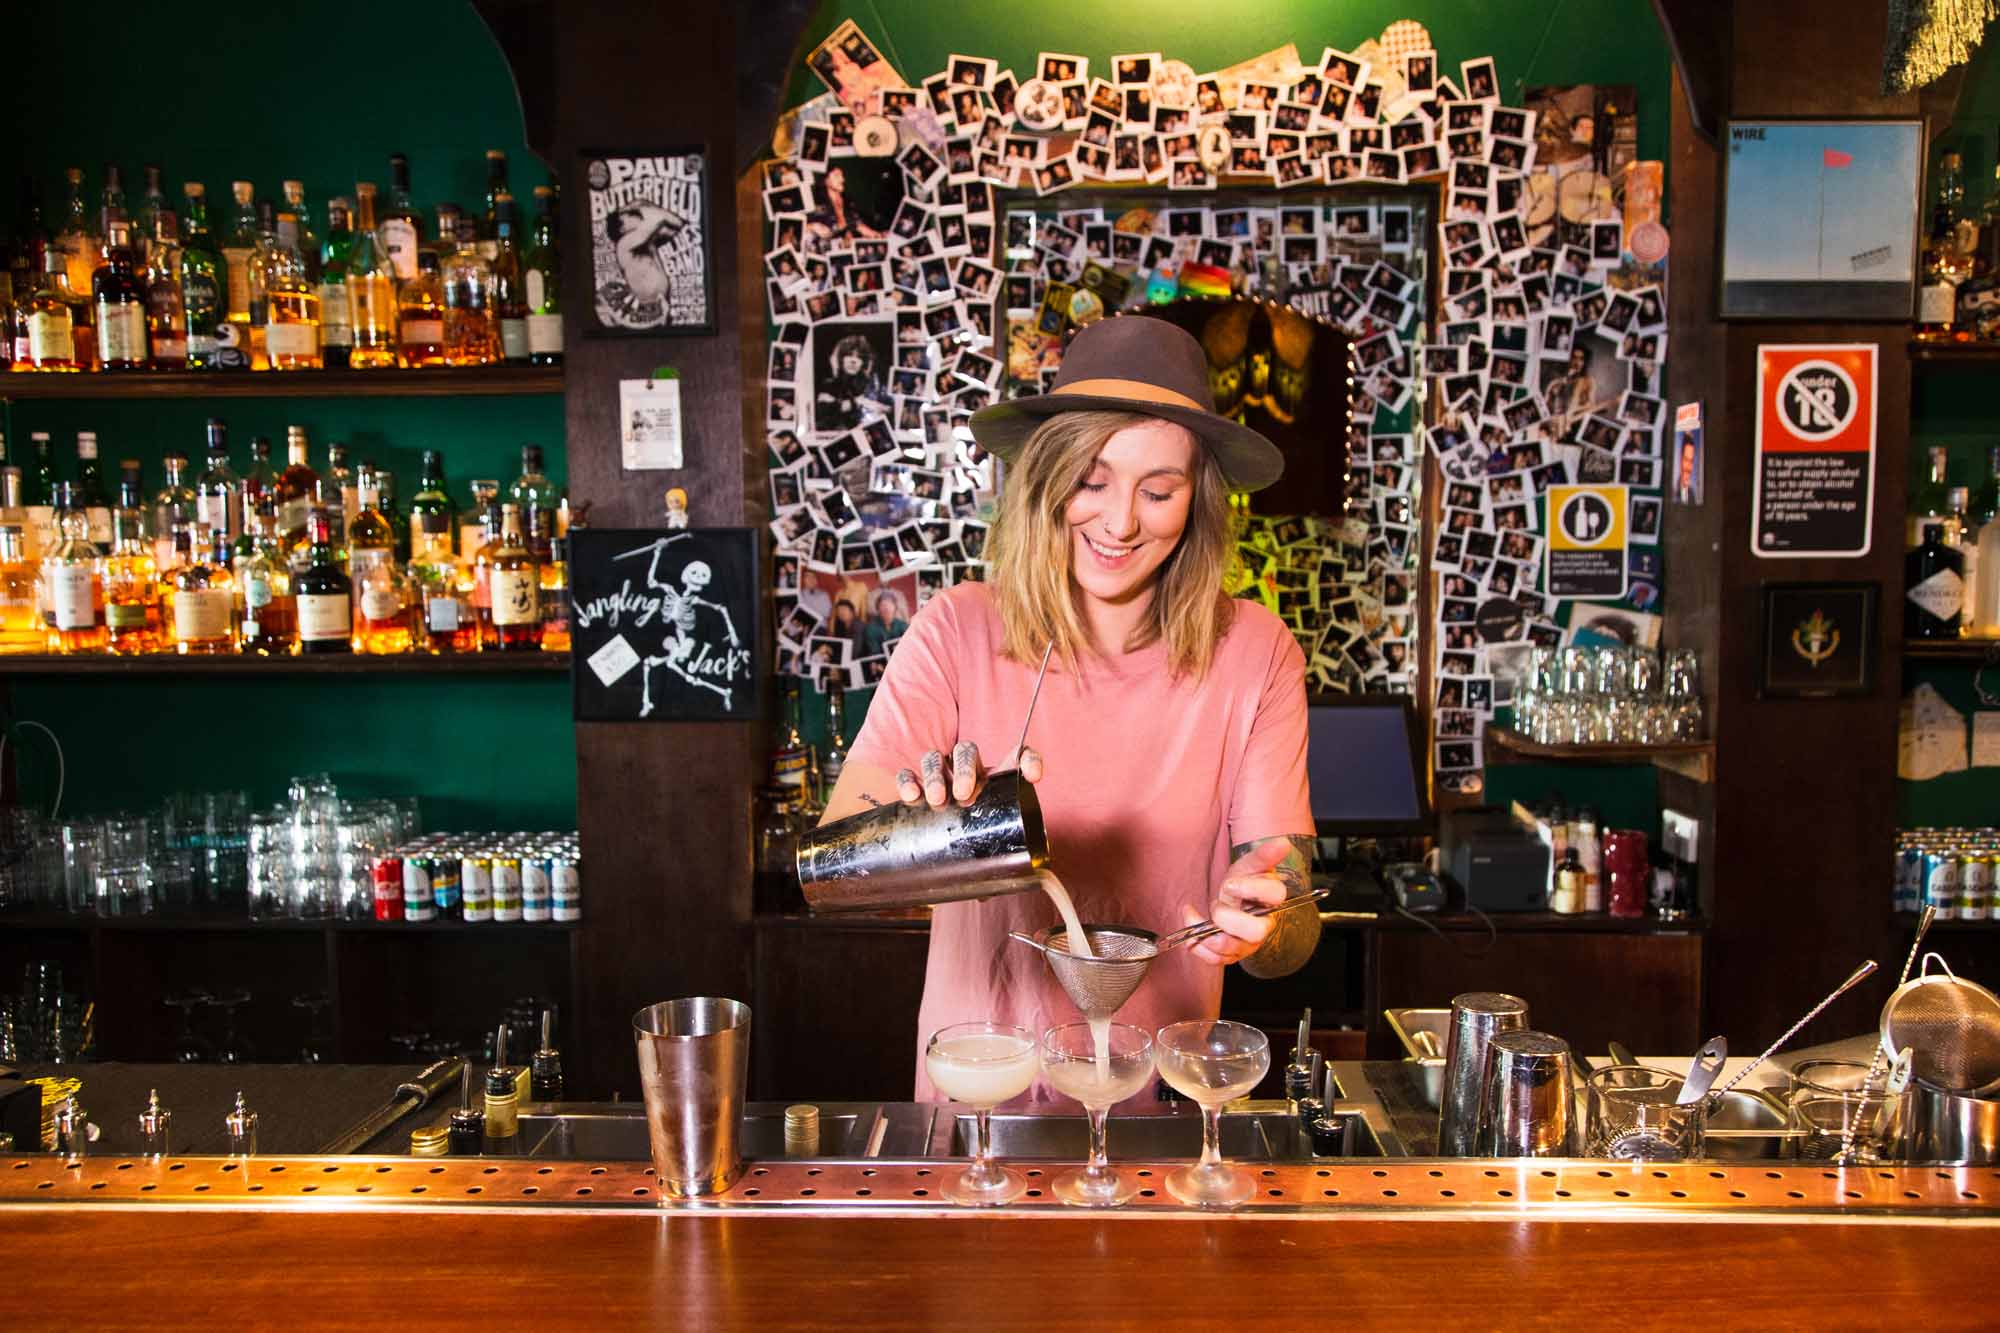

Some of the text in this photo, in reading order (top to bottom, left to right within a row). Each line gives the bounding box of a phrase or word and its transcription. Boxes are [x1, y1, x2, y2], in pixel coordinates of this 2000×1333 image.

[1731, 128, 1766, 140] WIRE
[606, 156, 700, 186] PAUL
[589, 176, 702, 222] BUTTERFIELD
[661, 245, 705, 277] BAND
[1801, 374, 1837, 388] under
[1794, 388, 1836, 427] 18
[573, 579, 661, 628] Jangling
[688, 642, 751, 681] Jack's
